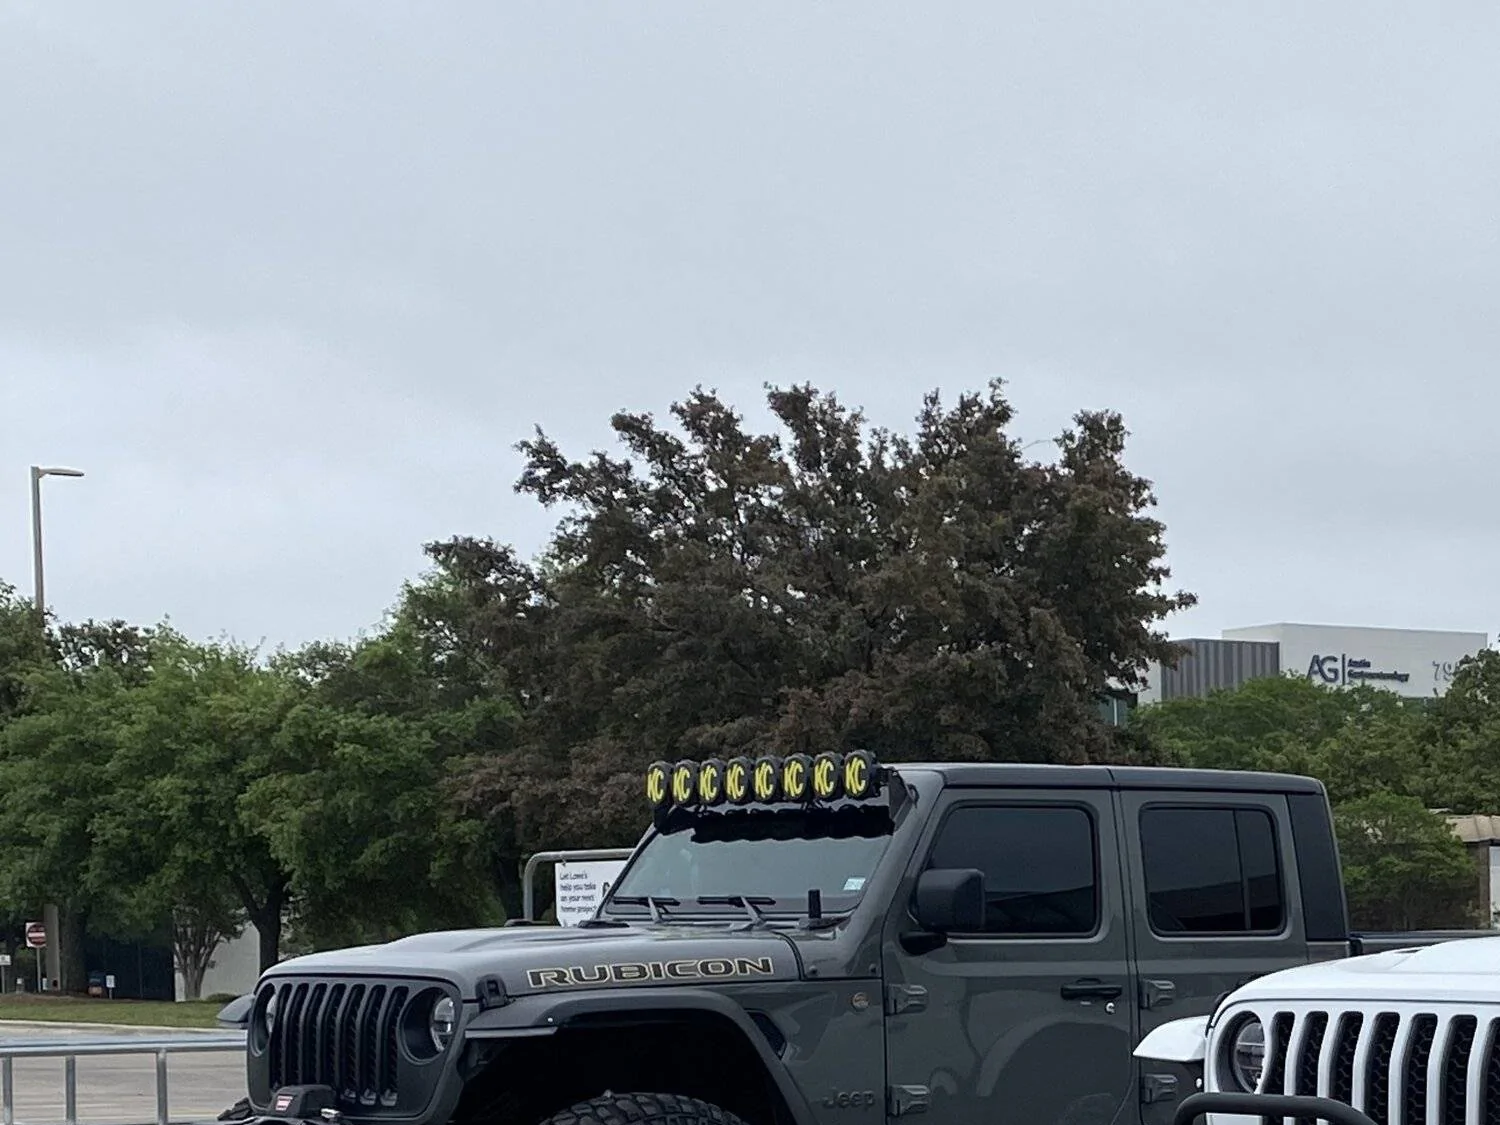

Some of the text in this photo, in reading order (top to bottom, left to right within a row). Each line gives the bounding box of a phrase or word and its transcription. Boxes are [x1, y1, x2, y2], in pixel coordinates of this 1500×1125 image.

[647, 768, 664, 801] KC
[673, 767, 690, 801] KC
[700, 765, 717, 800] KC
[726, 764, 744, 799] KC
[755, 762, 773, 798] KC
[784, 761, 803, 797] KC
[814, 759, 834, 795] KC
[845, 757, 866, 795] KC
[527, 957, 774, 989] RUBICON
